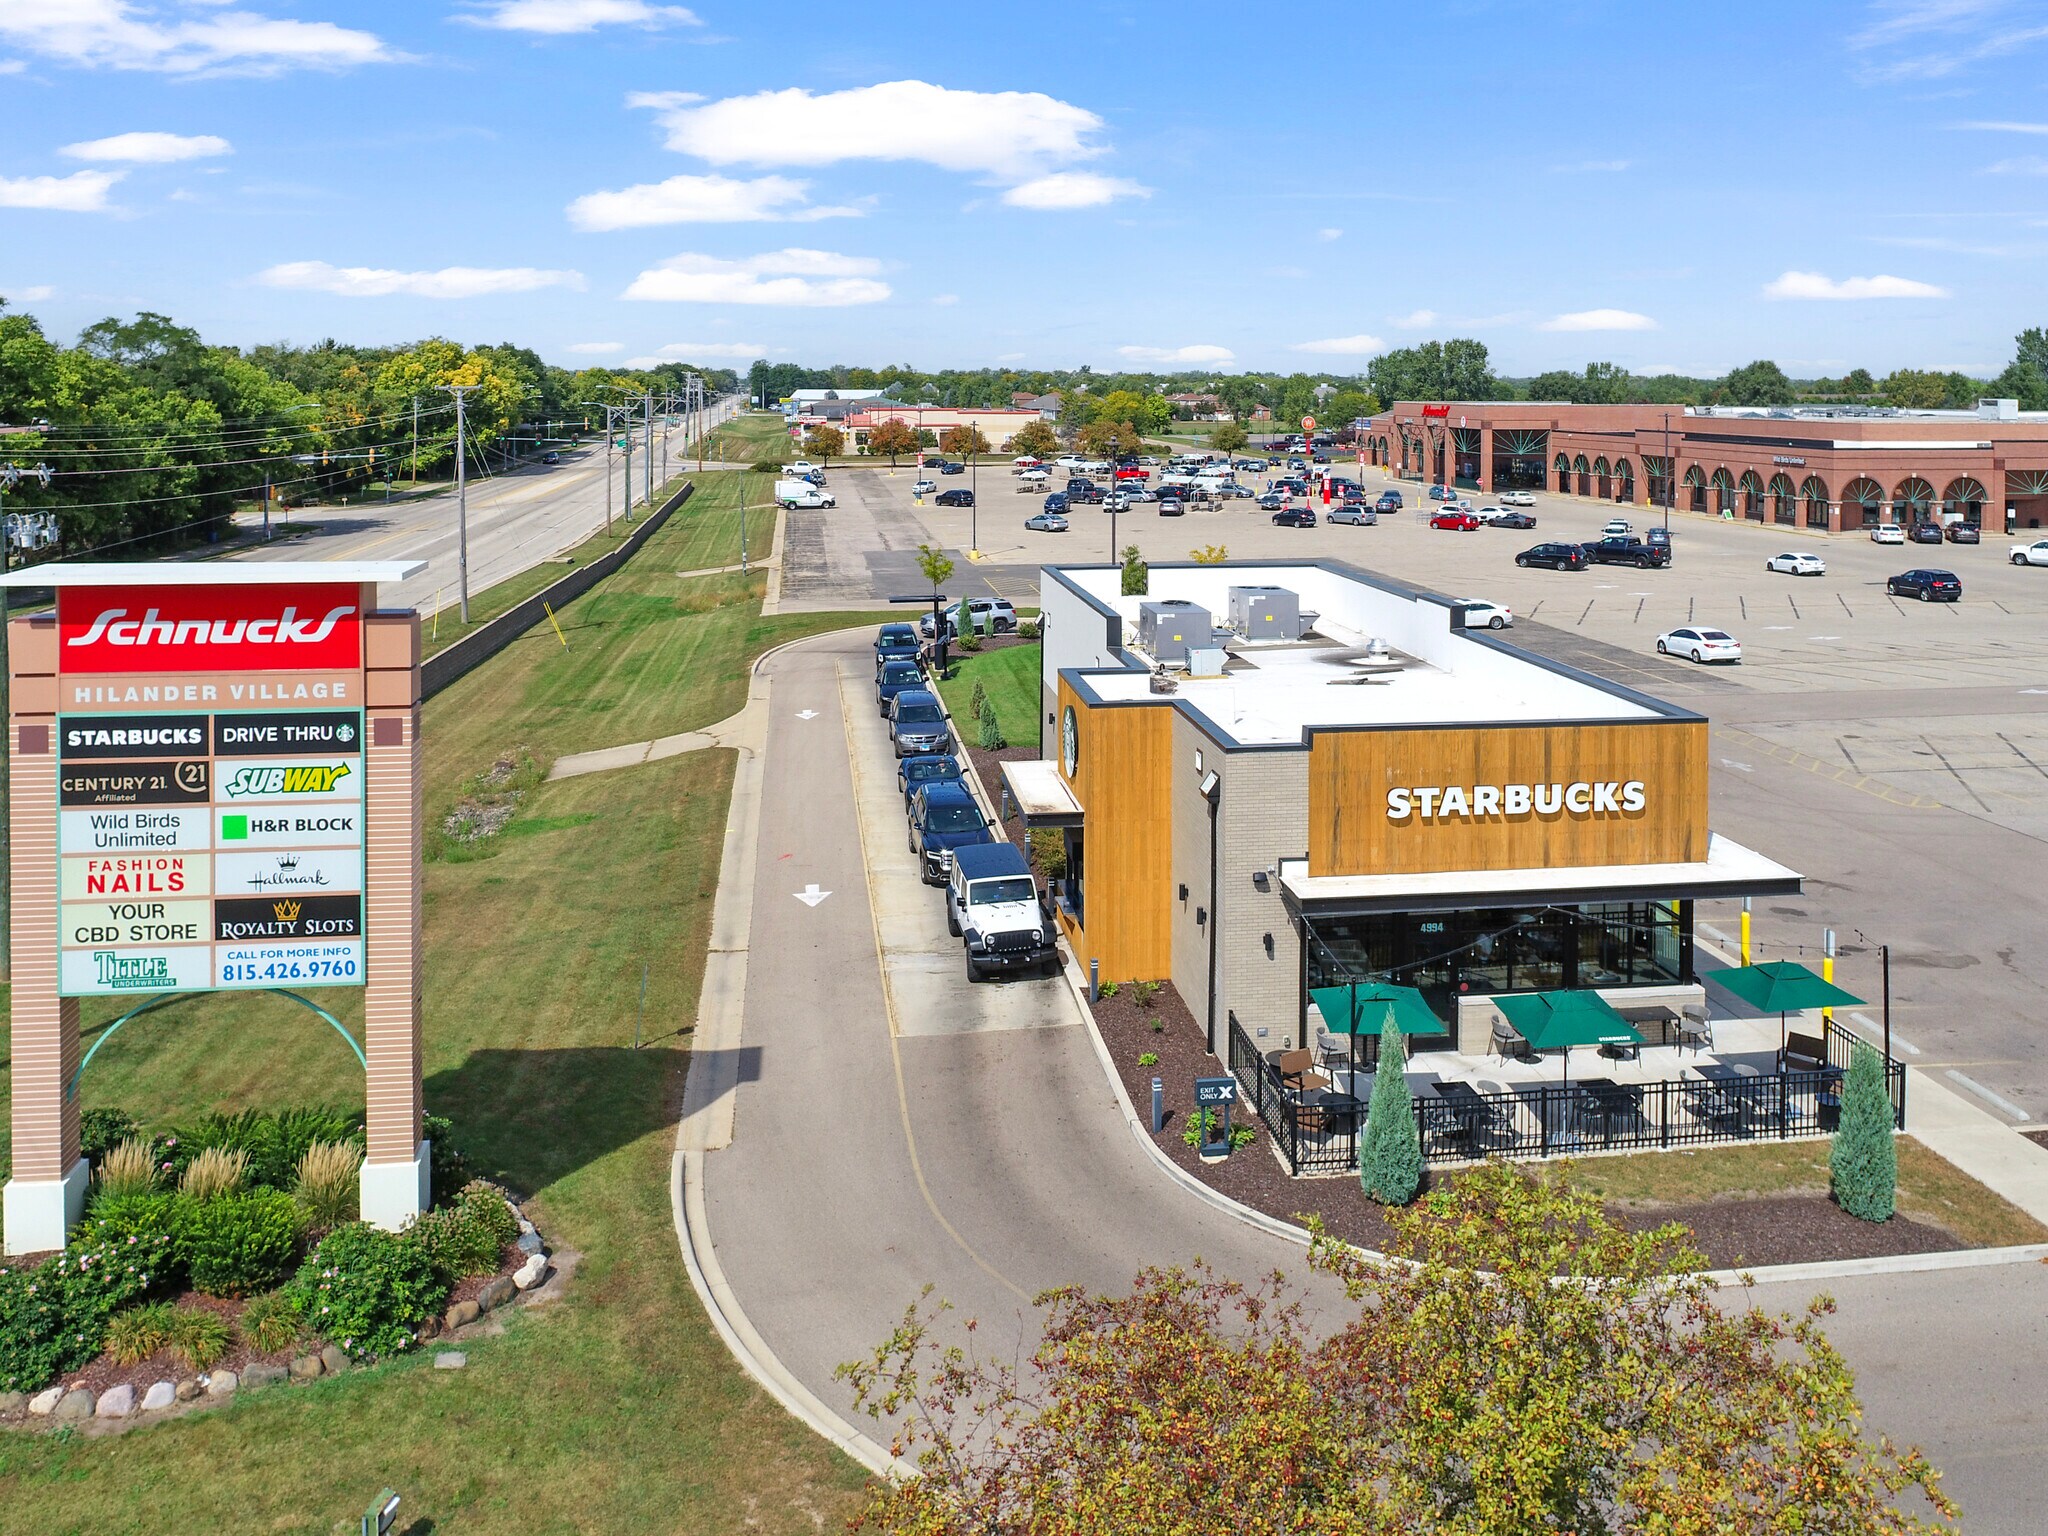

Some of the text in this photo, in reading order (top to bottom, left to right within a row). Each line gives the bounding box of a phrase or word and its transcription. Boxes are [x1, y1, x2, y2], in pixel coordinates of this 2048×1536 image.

[67, 605, 356, 647] Schnucks
[75, 682, 346, 703] HILANDER VILLAGE
[67, 728, 202, 746] STARBUCKS
[223, 725, 333, 743] DRIVE THRU
[62, 776, 146, 792] CENTURY
[226, 761, 351, 798] SUBWAY
[94, 793, 136, 803] Affiliated
[1386, 780, 1646, 819] STARBUCKS
[90, 813, 181, 830] Wild Birds
[251, 816, 353, 833] H&R BLOCK
[95, 831, 177, 848] Unlimited
[88, 858, 184, 873] FASHION
[87, 873, 185, 894] NAILS
[247, 870, 330, 893] Hallmark
[109, 903, 165, 920] YOUR
[74, 924, 197, 943] CBD STORE
[220, 918, 354, 939] ROYALTY SLOTS
[1420, 922, 1443, 934] 4994
[227, 946, 351, 961] CALL FOR MORE INFO
[94, 951, 168, 984] TITLE
[223, 960, 356, 982] 815.426.9760
[114, 979, 175, 988] UNDERWRITERS
